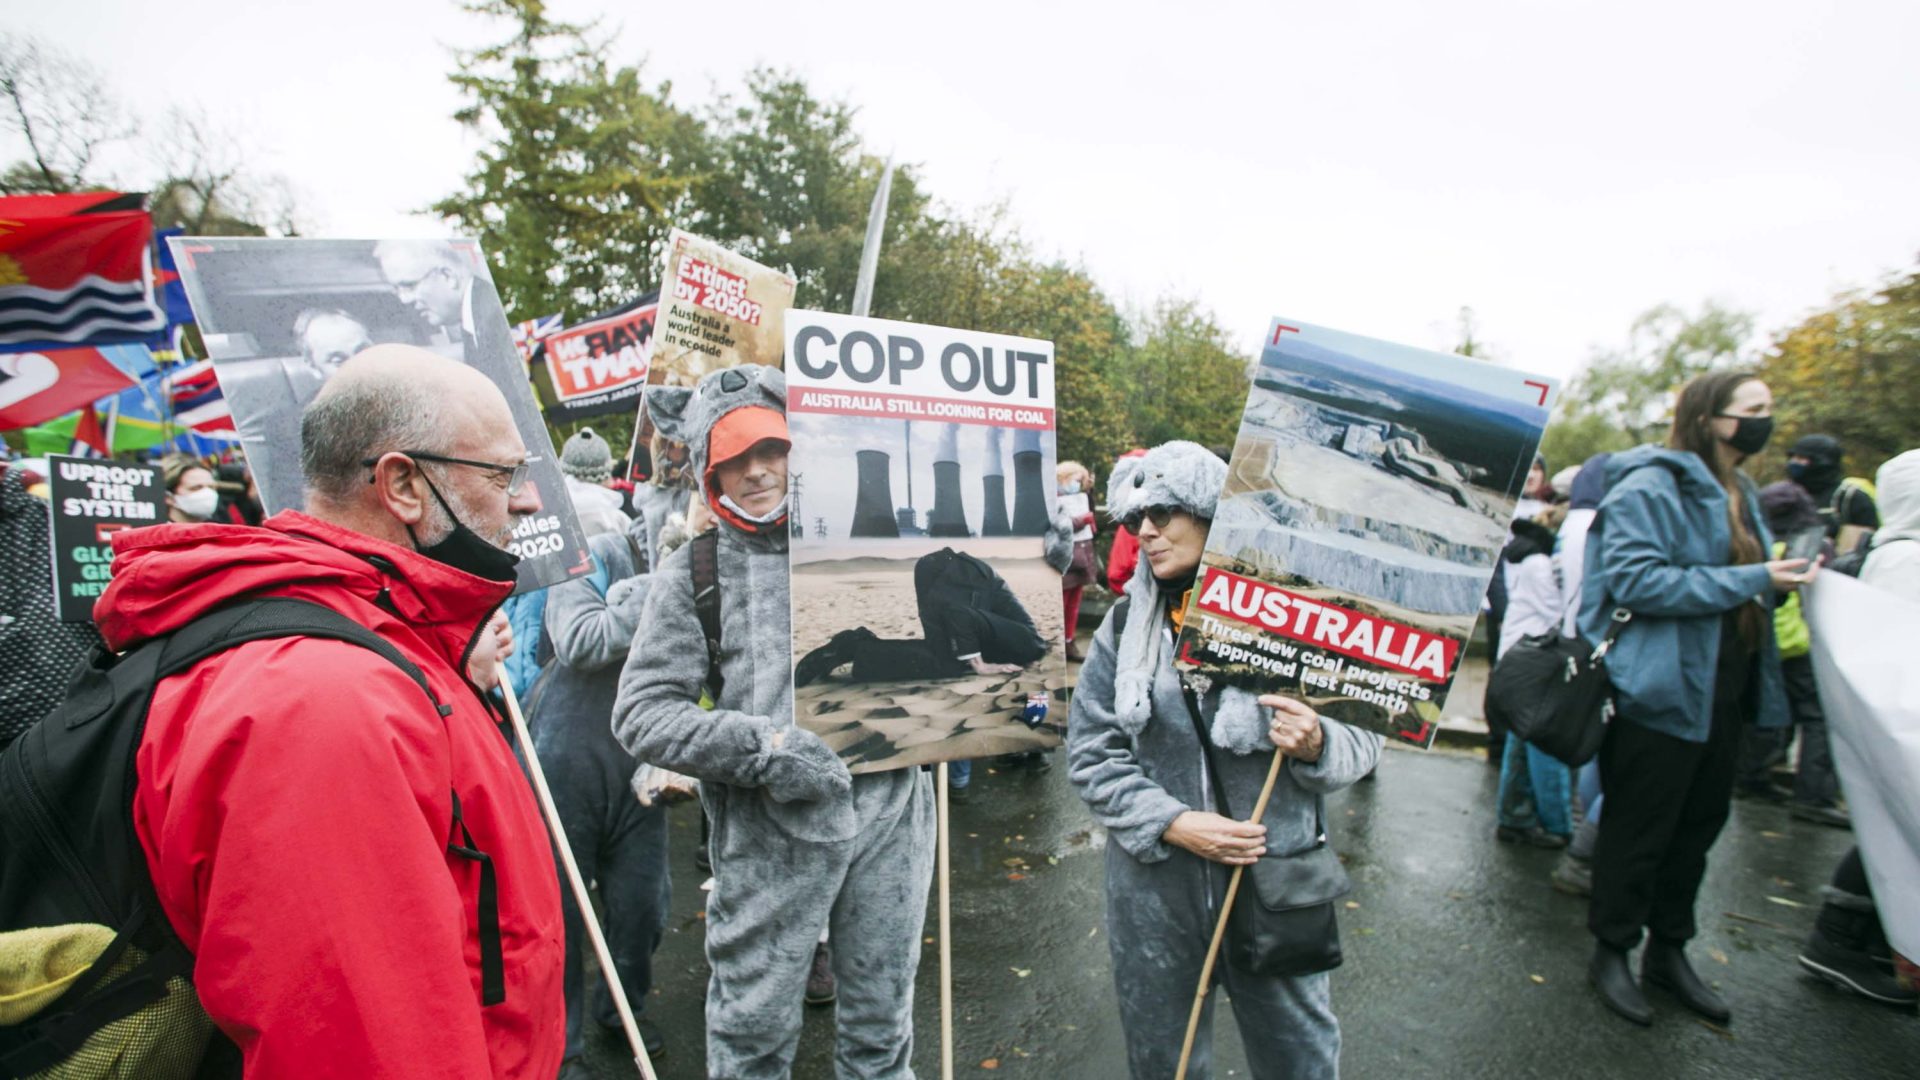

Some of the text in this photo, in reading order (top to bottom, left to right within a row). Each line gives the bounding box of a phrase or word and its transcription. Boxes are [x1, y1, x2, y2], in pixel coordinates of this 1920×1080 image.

[677, 254, 747, 298] Extinct
[674, 276, 761, 325] by 2050?
[670, 304, 730, 333] Australia a
[665, 331, 722, 357] in ecoside
[668, 320, 735, 348] world leader
[793, 325, 1048, 399] COP OUT
[801, 392, 1047, 424] AUSTRALIA STILL LOOKING FOR COAL
[60, 462, 154, 486] UPROOT
[87, 482, 134, 501] THE
[63, 498, 156, 519] SYSTEM
[507, 532, 564, 561] 2020
[1199, 575, 1446, 678] AUSTRALIA
[1201, 615, 1431, 700] Three new coal projects
[1207, 640, 1409, 714] approved last month
